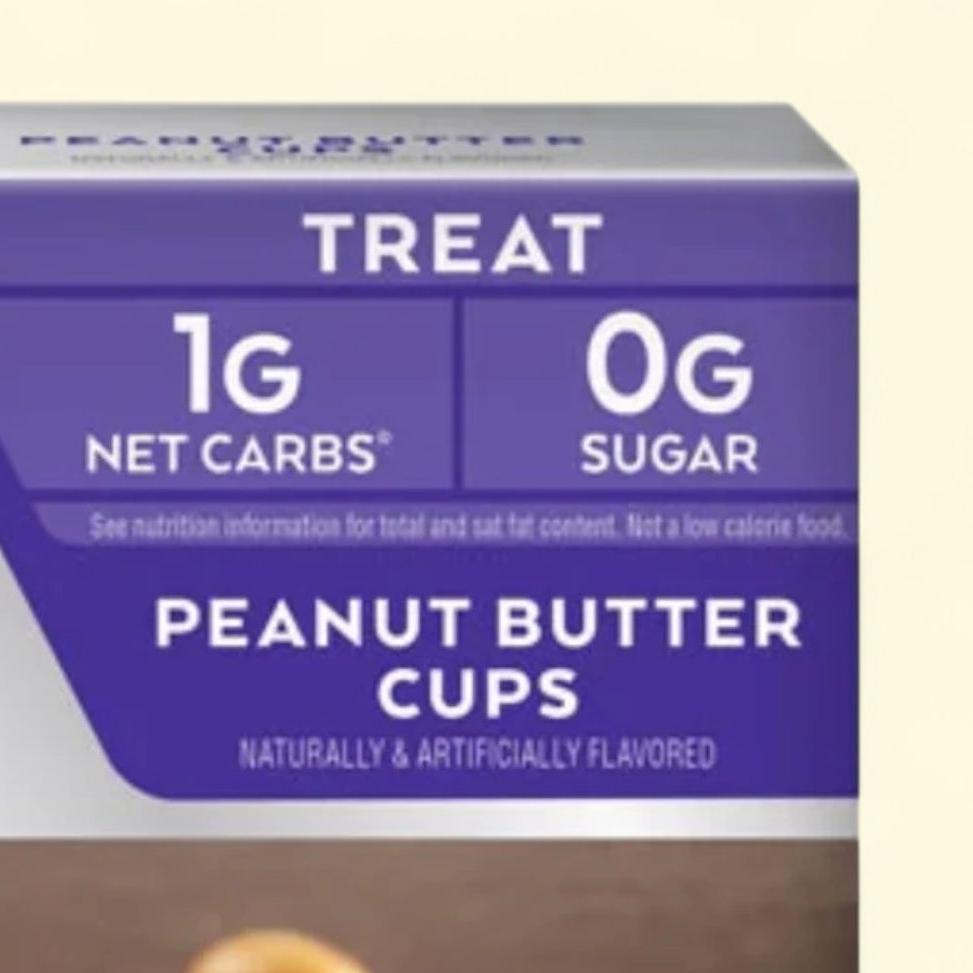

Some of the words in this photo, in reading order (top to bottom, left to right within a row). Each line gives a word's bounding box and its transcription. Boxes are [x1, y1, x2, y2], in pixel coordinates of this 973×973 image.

[302, 214, 604, 274] TREAT
[172, 312, 302, 415] 1G
[585, 310, 754, 416] 0G
[86, 433, 189, 474] NET
[580, 433, 759, 475] SUGAR
[89, 513, 128, 539] See
[132, 513, 220, 539] nutrition
[224, 513, 341, 539] information
[345, 513, 375, 539] for
[379, 513, 426, 539] total
[430, 513, 467, 539] and
[473, 513, 503, 539] sat
[508, 513, 535, 539] fat
[540, 513, 622, 539] content.
[628, 513, 661, 539] Not
[665, 519, 680, 539] a
[683, 513, 719, 539] low
[724, 513, 792, 539] calorie
[796, 513, 848, 539] food.
[155, 598, 470, 648] PEANUT
[498, 598, 802, 648] BUTTER
[378, 669, 580, 719] CUPS
[239, 737, 386, 769] NATURALLY
[391, 737, 409, 769] &
[416, 737, 581, 769] ARTIFICIALLY
[587, 737, 718, 769] FLAVORED
